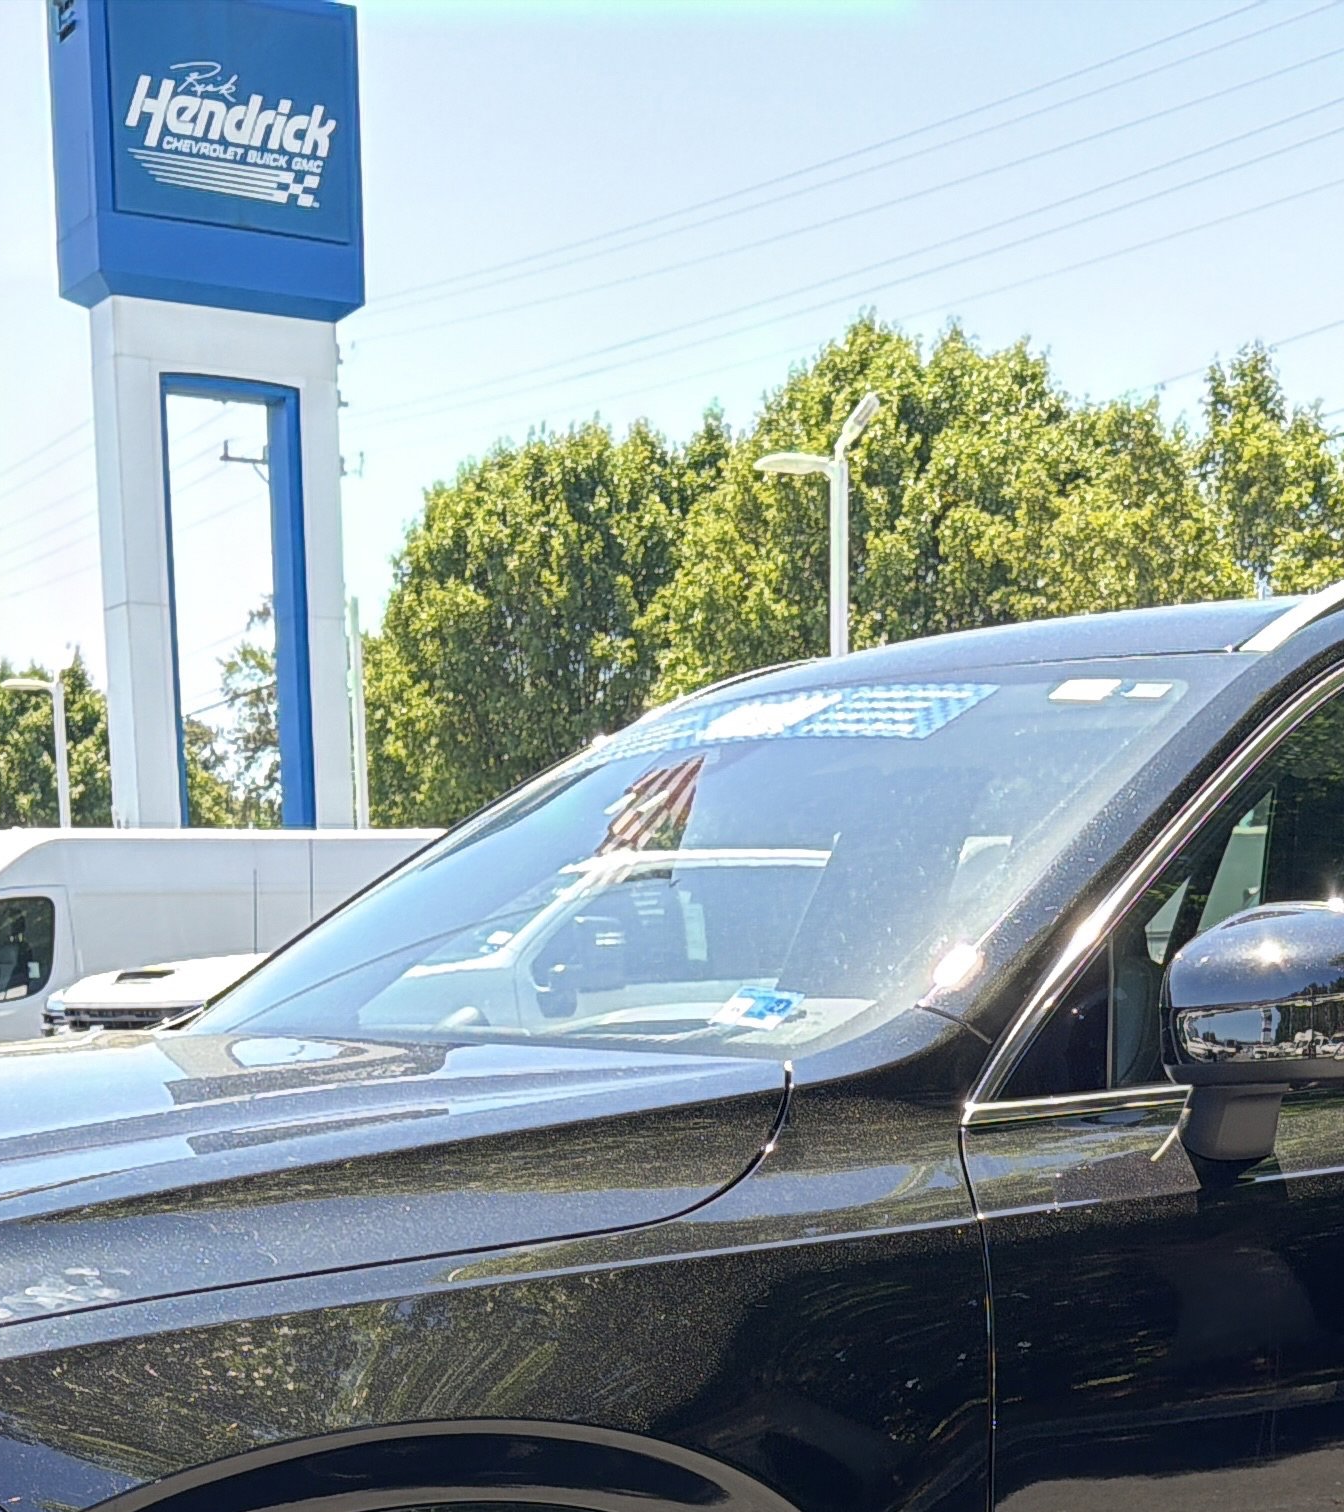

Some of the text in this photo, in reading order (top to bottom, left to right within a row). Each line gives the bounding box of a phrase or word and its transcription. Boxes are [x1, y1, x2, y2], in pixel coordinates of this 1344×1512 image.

[125, 74, 337, 158] Hendrick
[162, 136, 324, 173] CHEVROLET BUICK GMC
